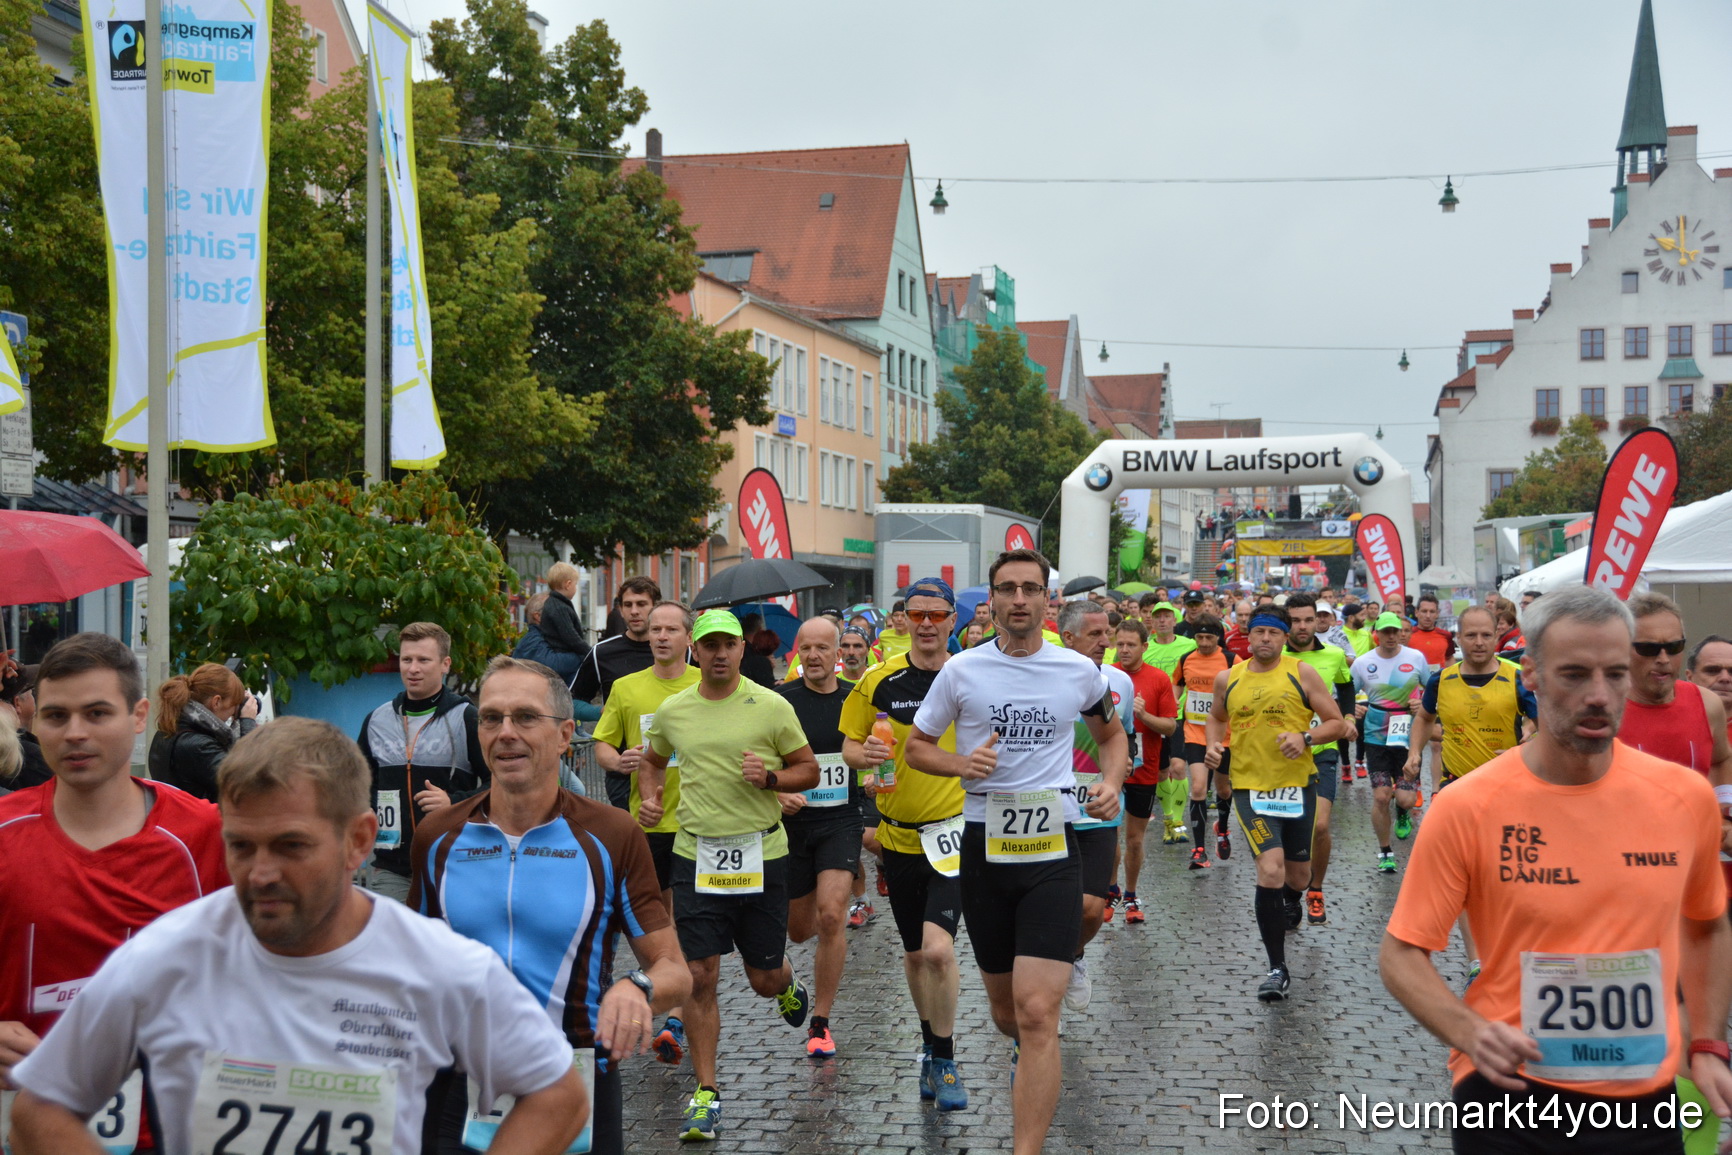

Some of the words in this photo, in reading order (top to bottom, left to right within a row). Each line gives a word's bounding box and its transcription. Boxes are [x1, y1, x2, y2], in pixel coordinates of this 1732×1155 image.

[1122, 450, 1198, 472] BMW
[1206, 447, 1342, 474] Laufsport
[1592, 453, 1667, 597] REWE
[1281, 542, 1308, 552] ZIEL
[994, 726, 1053, 738] Müller
[812, 792, 834, 800] Marco
[1002, 806, 1050, 834] 272
[1502, 823, 1547, 846] FÖR
[1001, 840, 1052, 852] Alexander
[1500, 845, 1539, 864] DIG
[716, 848, 743, 870] 29
[1622, 851, 1678, 866] THULE
[708, 876, 752, 886] Alexander
[1586, 954, 1651, 972] BOCK
[1537, 982, 1654, 1030] 2500
[1572, 1044, 1624, 1062] Muris
[216, 1072, 277, 1090] NeuerMarkt
[288, 1068, 382, 1096] BOCK
[212, 1098, 376, 1155] 2743
